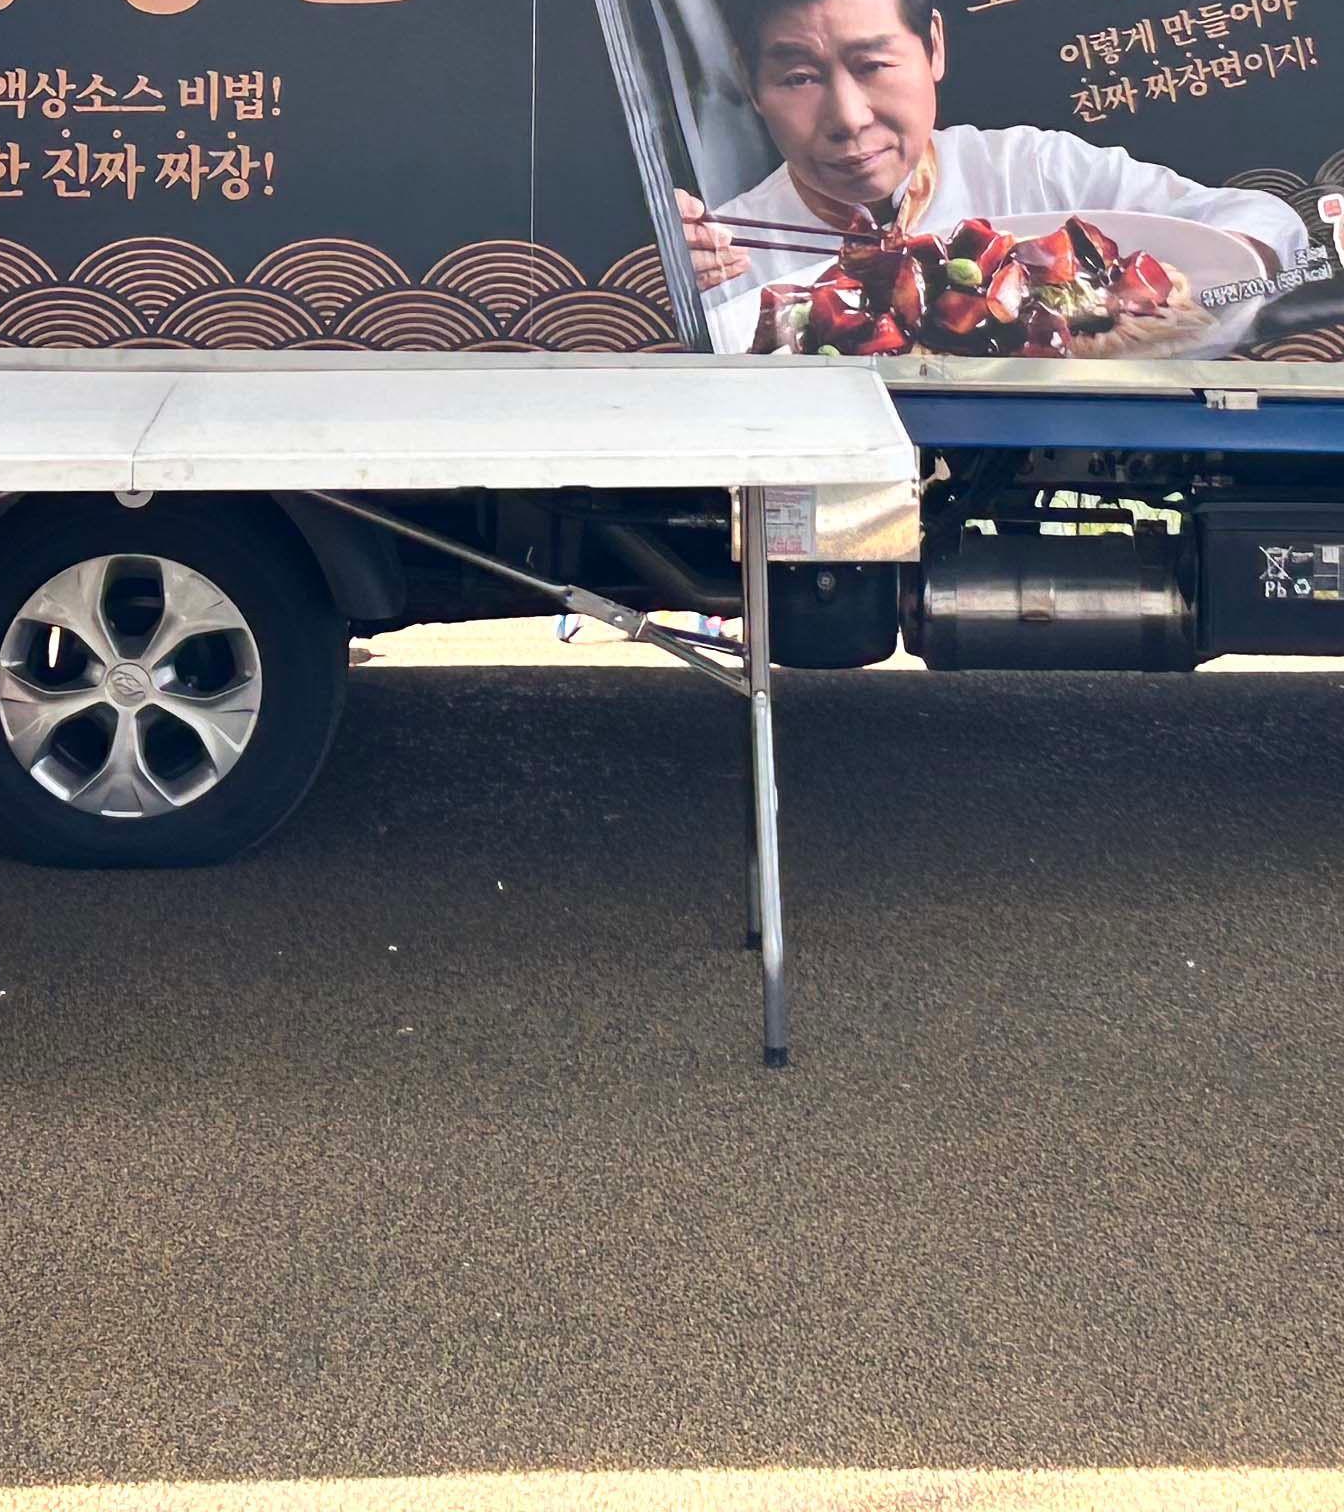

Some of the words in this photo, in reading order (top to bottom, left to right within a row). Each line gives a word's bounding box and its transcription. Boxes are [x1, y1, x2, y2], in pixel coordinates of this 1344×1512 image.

[1059, 19, 1157, 70] 이렇게
[178, 69, 283, 120] 비법!
[1069, 74, 1138, 124] 진짜
[1144, 36, 1319, 105] 짜장면이지!
[41, 142, 146, 201] 진짜
[155, 143, 276, 201] 짜장!
